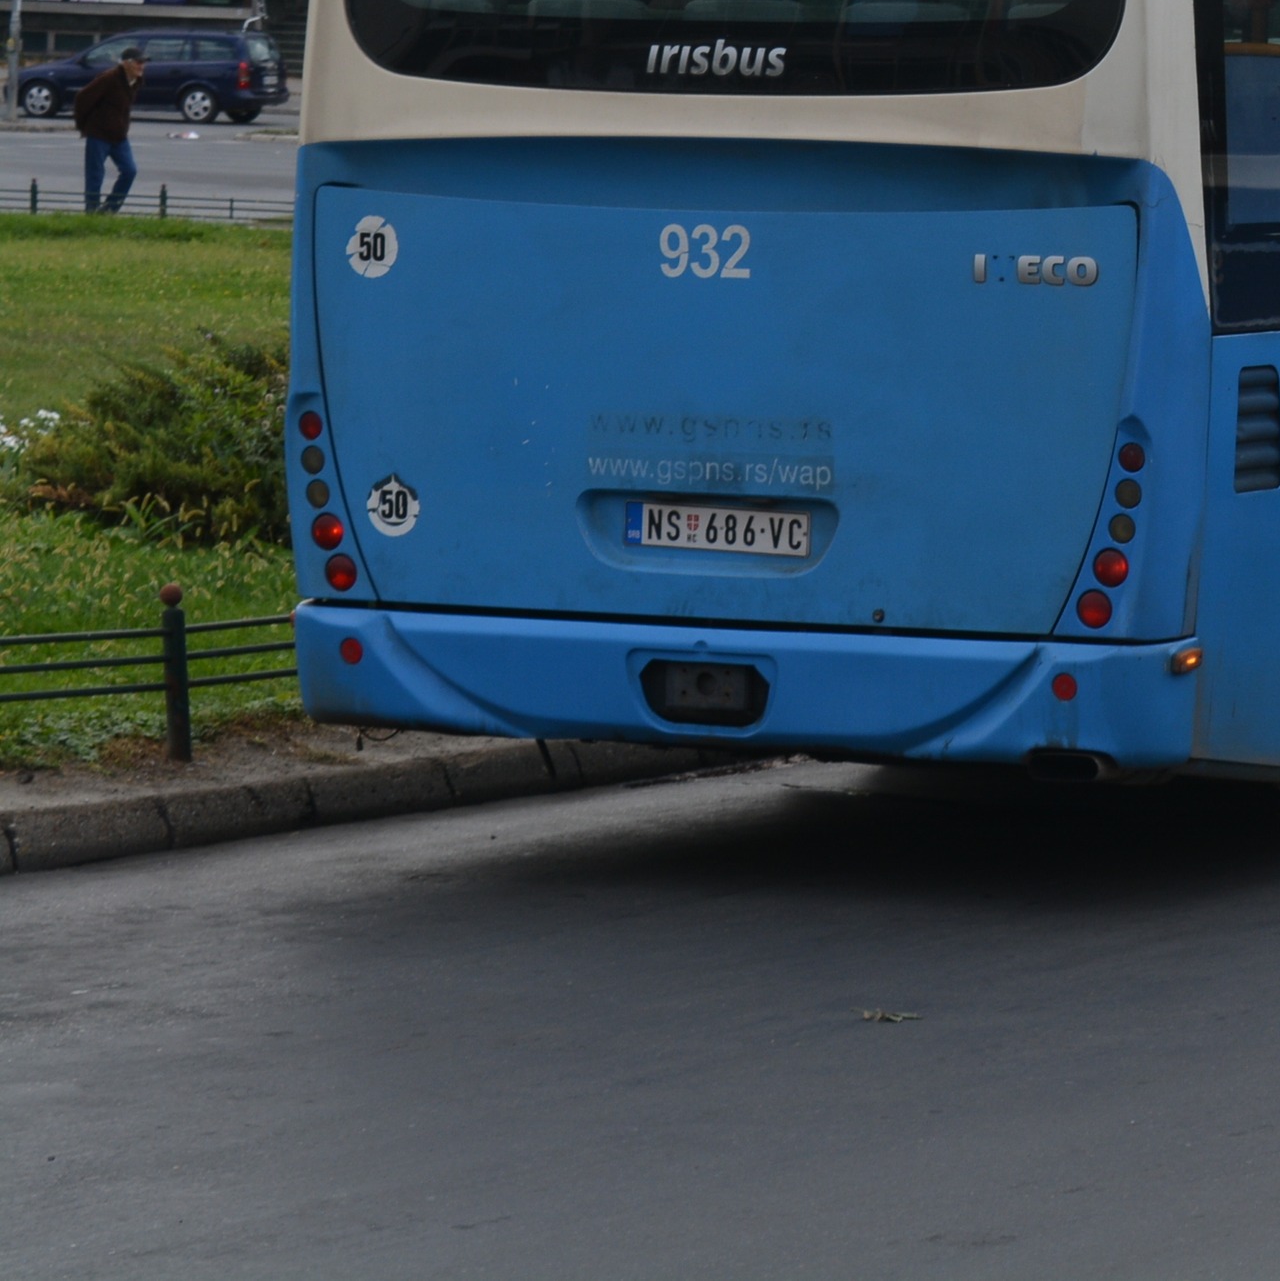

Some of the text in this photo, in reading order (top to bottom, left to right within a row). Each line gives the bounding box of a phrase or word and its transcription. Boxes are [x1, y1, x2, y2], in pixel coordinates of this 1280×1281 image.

[645, 38, 787, 77] irisbus
[359, 232, 386, 262] 50
[659, 223, 751, 279] 932
[380, 490, 408, 520] 50
[647, 509, 680, 541] NS
